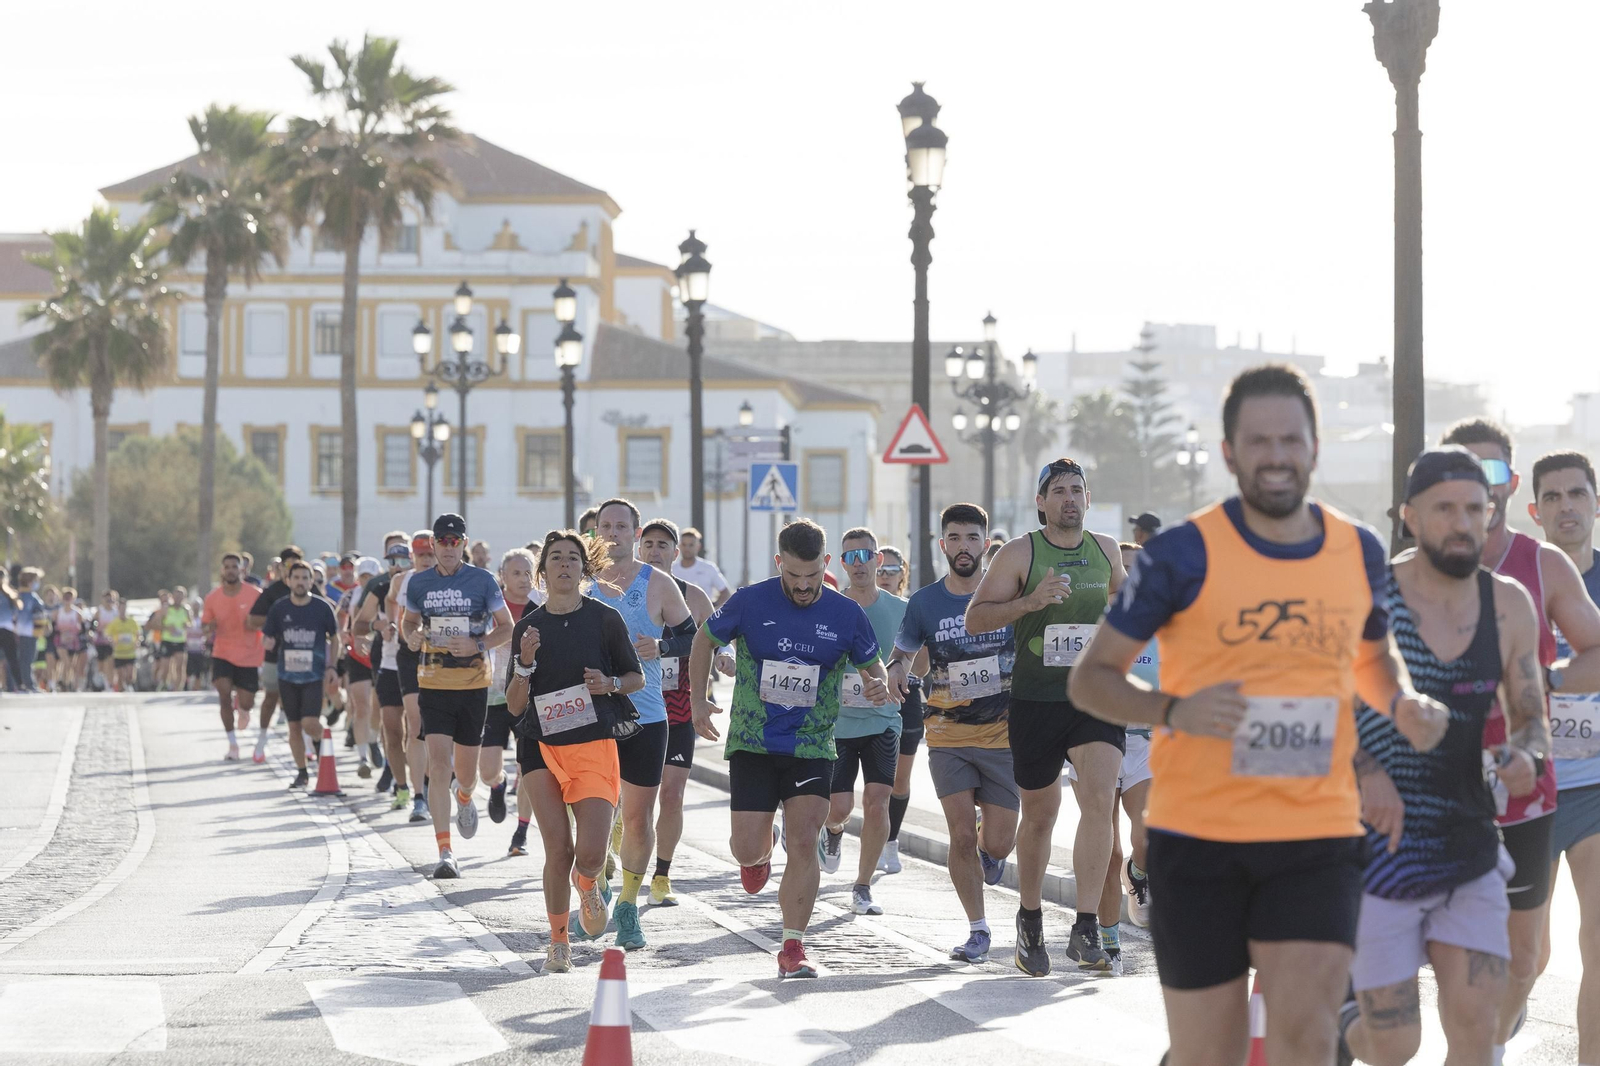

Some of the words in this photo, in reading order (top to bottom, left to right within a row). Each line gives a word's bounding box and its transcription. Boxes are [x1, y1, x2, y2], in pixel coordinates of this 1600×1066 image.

[427, 588, 462, 600] media
[423, 598, 472, 609] maraton
[438, 626, 460, 637] 768
[816, 629, 838, 639] Sevilla
[794, 642, 815, 654] CEU
[769, 673, 811, 693] 1478
[960, 669, 990, 686] 318
[543, 697, 586, 721] 2259
[1248, 720, 1322, 750] 2084
